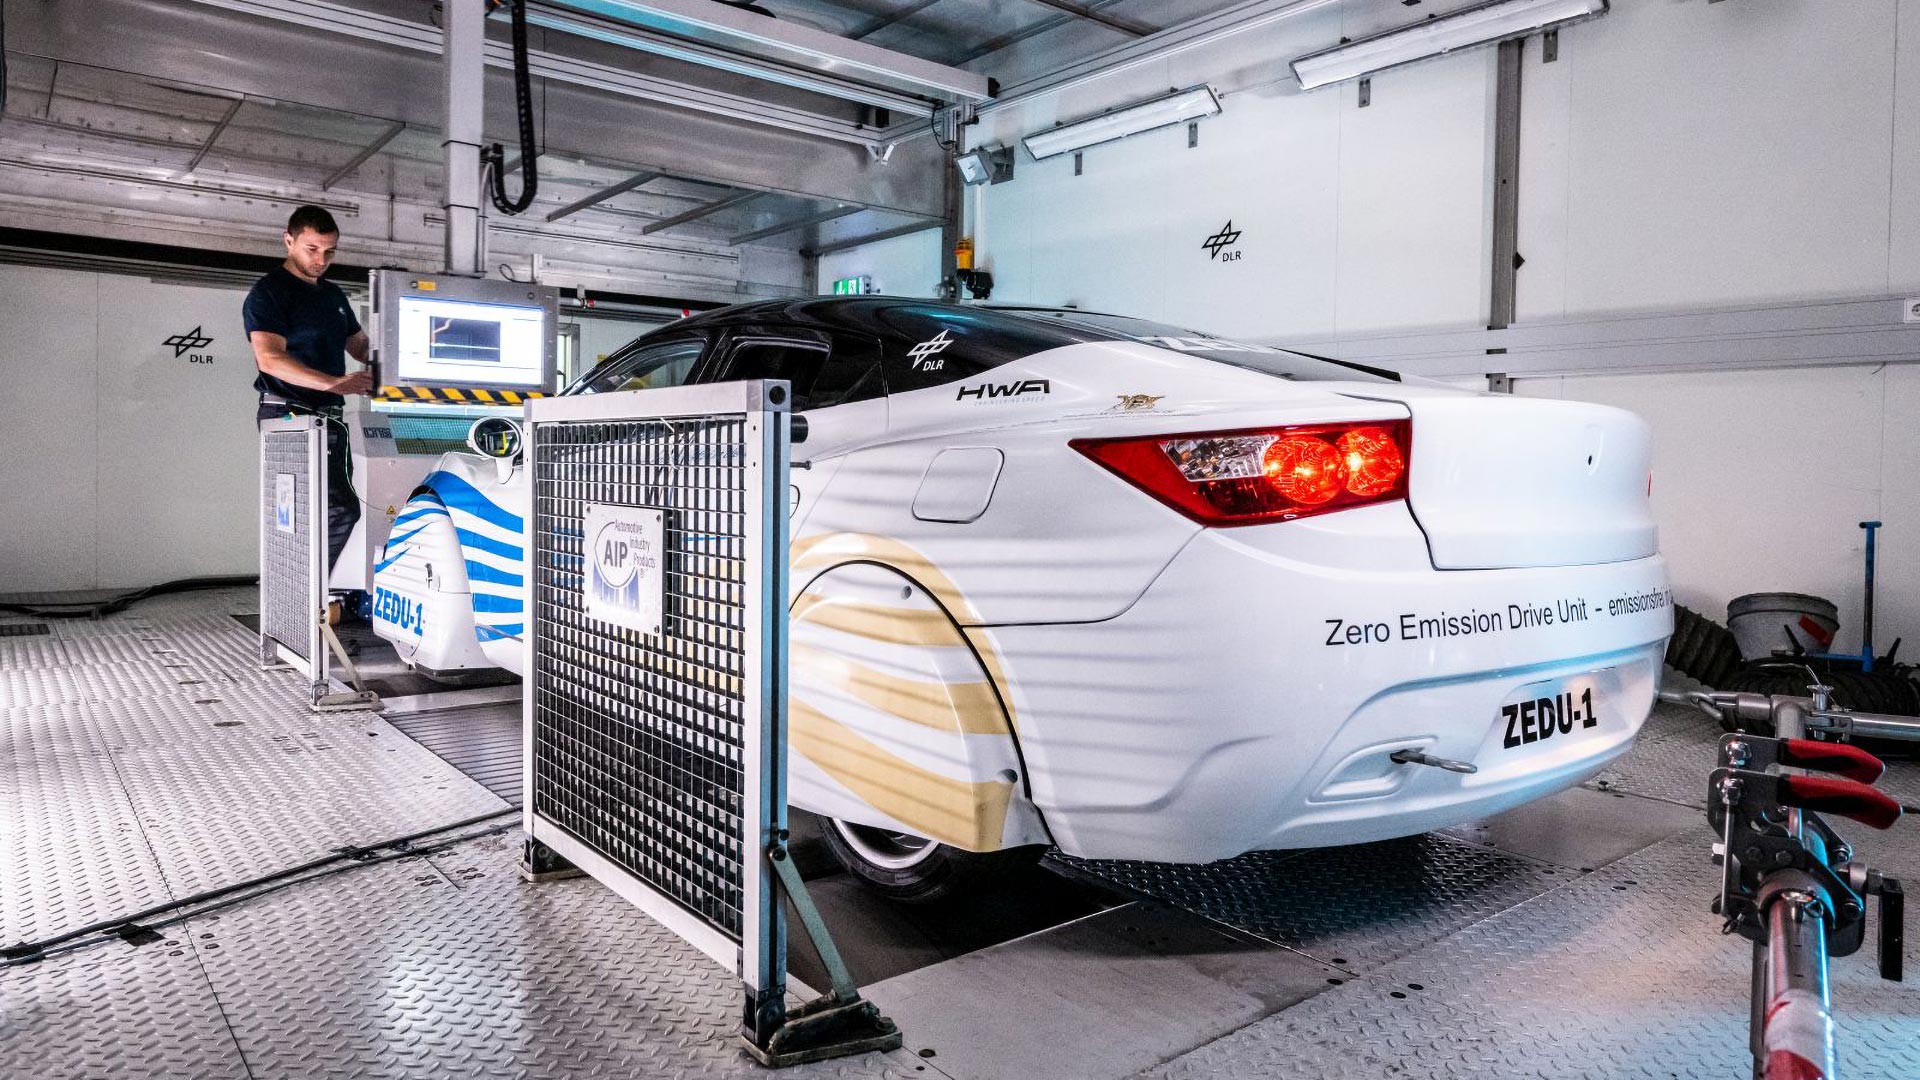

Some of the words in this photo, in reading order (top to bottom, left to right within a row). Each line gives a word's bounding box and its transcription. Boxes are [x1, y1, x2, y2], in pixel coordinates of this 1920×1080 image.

[1223, 250, 1241, 262] DLR
[190, 354, 213, 364] DLR
[923, 360, 944, 371] DLR
[956, 379, 1050, 401] HWA
[604, 539, 628, 568] AIP
[374, 586, 423, 637] ZEDU-1
[1325, 619, 1390, 645] Zero
[1400, 608, 1502, 640] Emission
[1508, 603, 1553, 629] Drive
[1558, 597, 1588, 623] Unit
[1502, 688, 1597, 749] ZEDU-1
